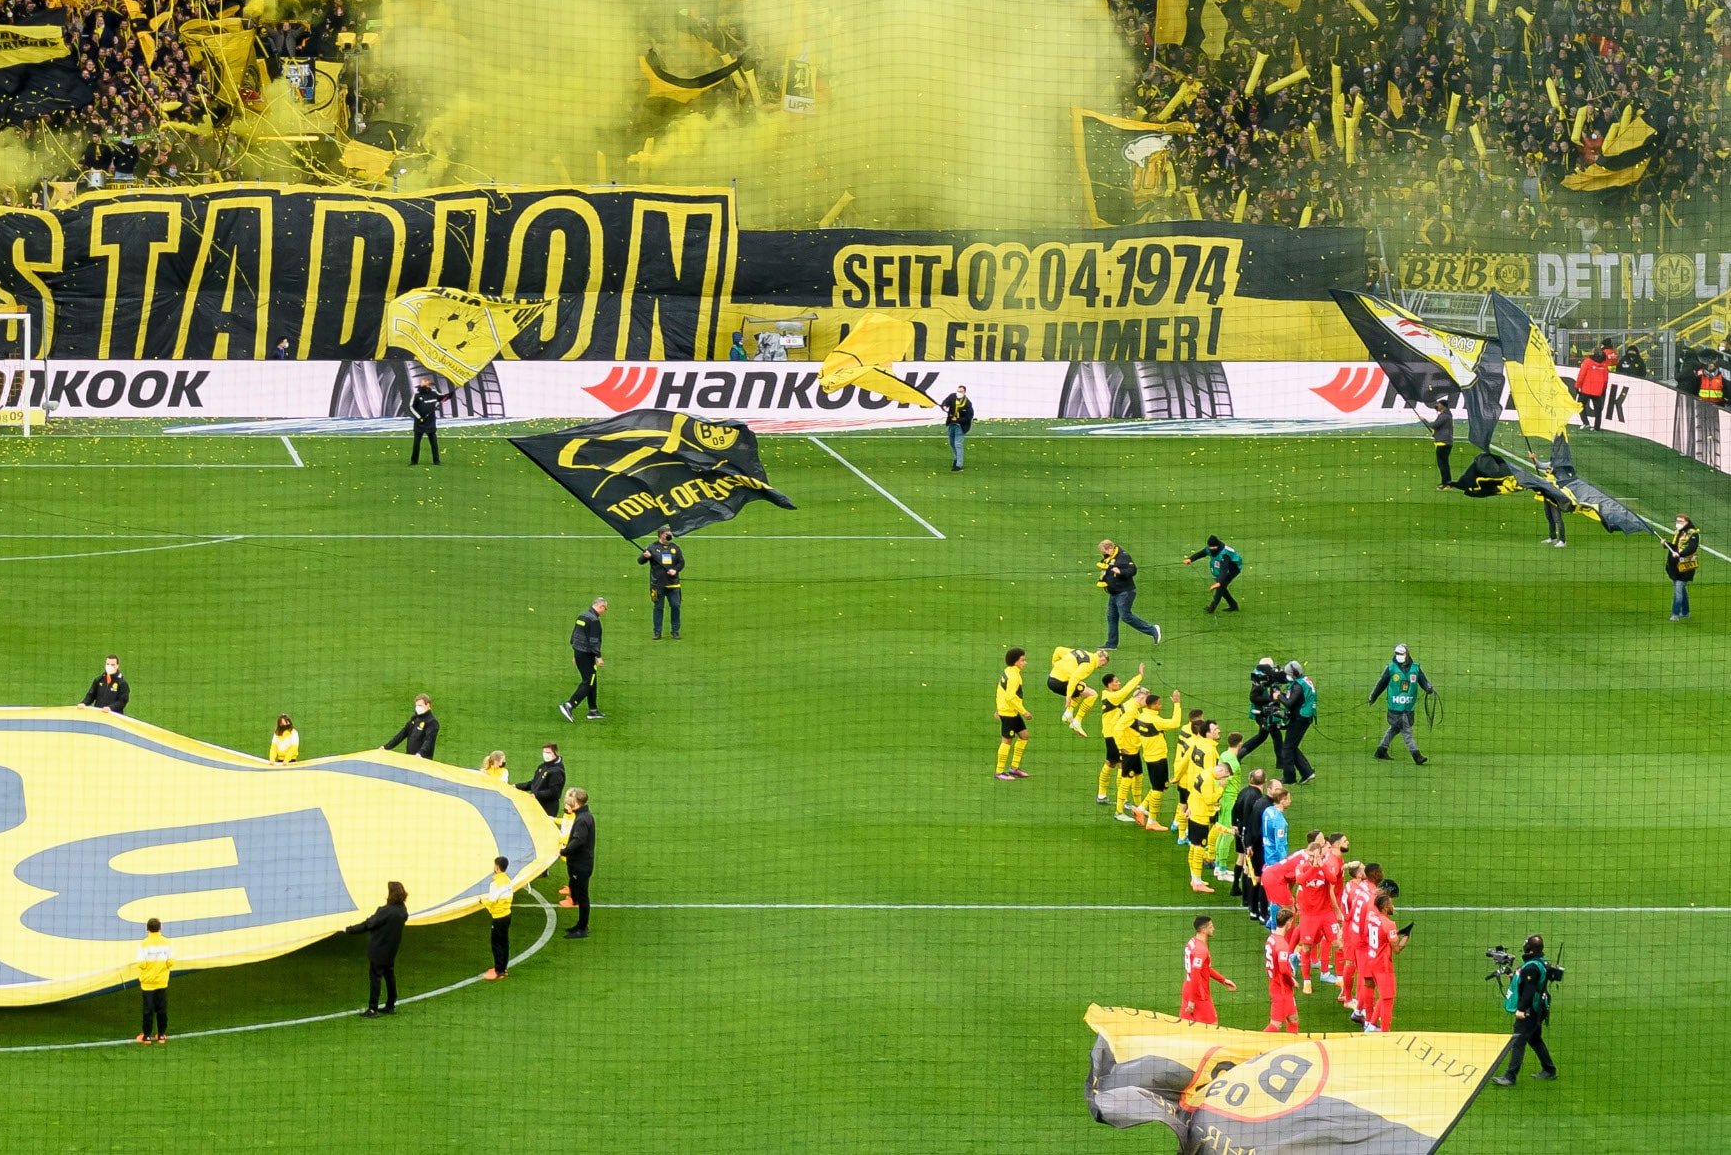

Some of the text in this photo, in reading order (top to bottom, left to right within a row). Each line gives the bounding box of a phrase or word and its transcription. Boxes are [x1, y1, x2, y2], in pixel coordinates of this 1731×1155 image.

[843, 244, 1229, 313] SEIT 02.04.1974
[1391, 695, 1414, 705] HOST
